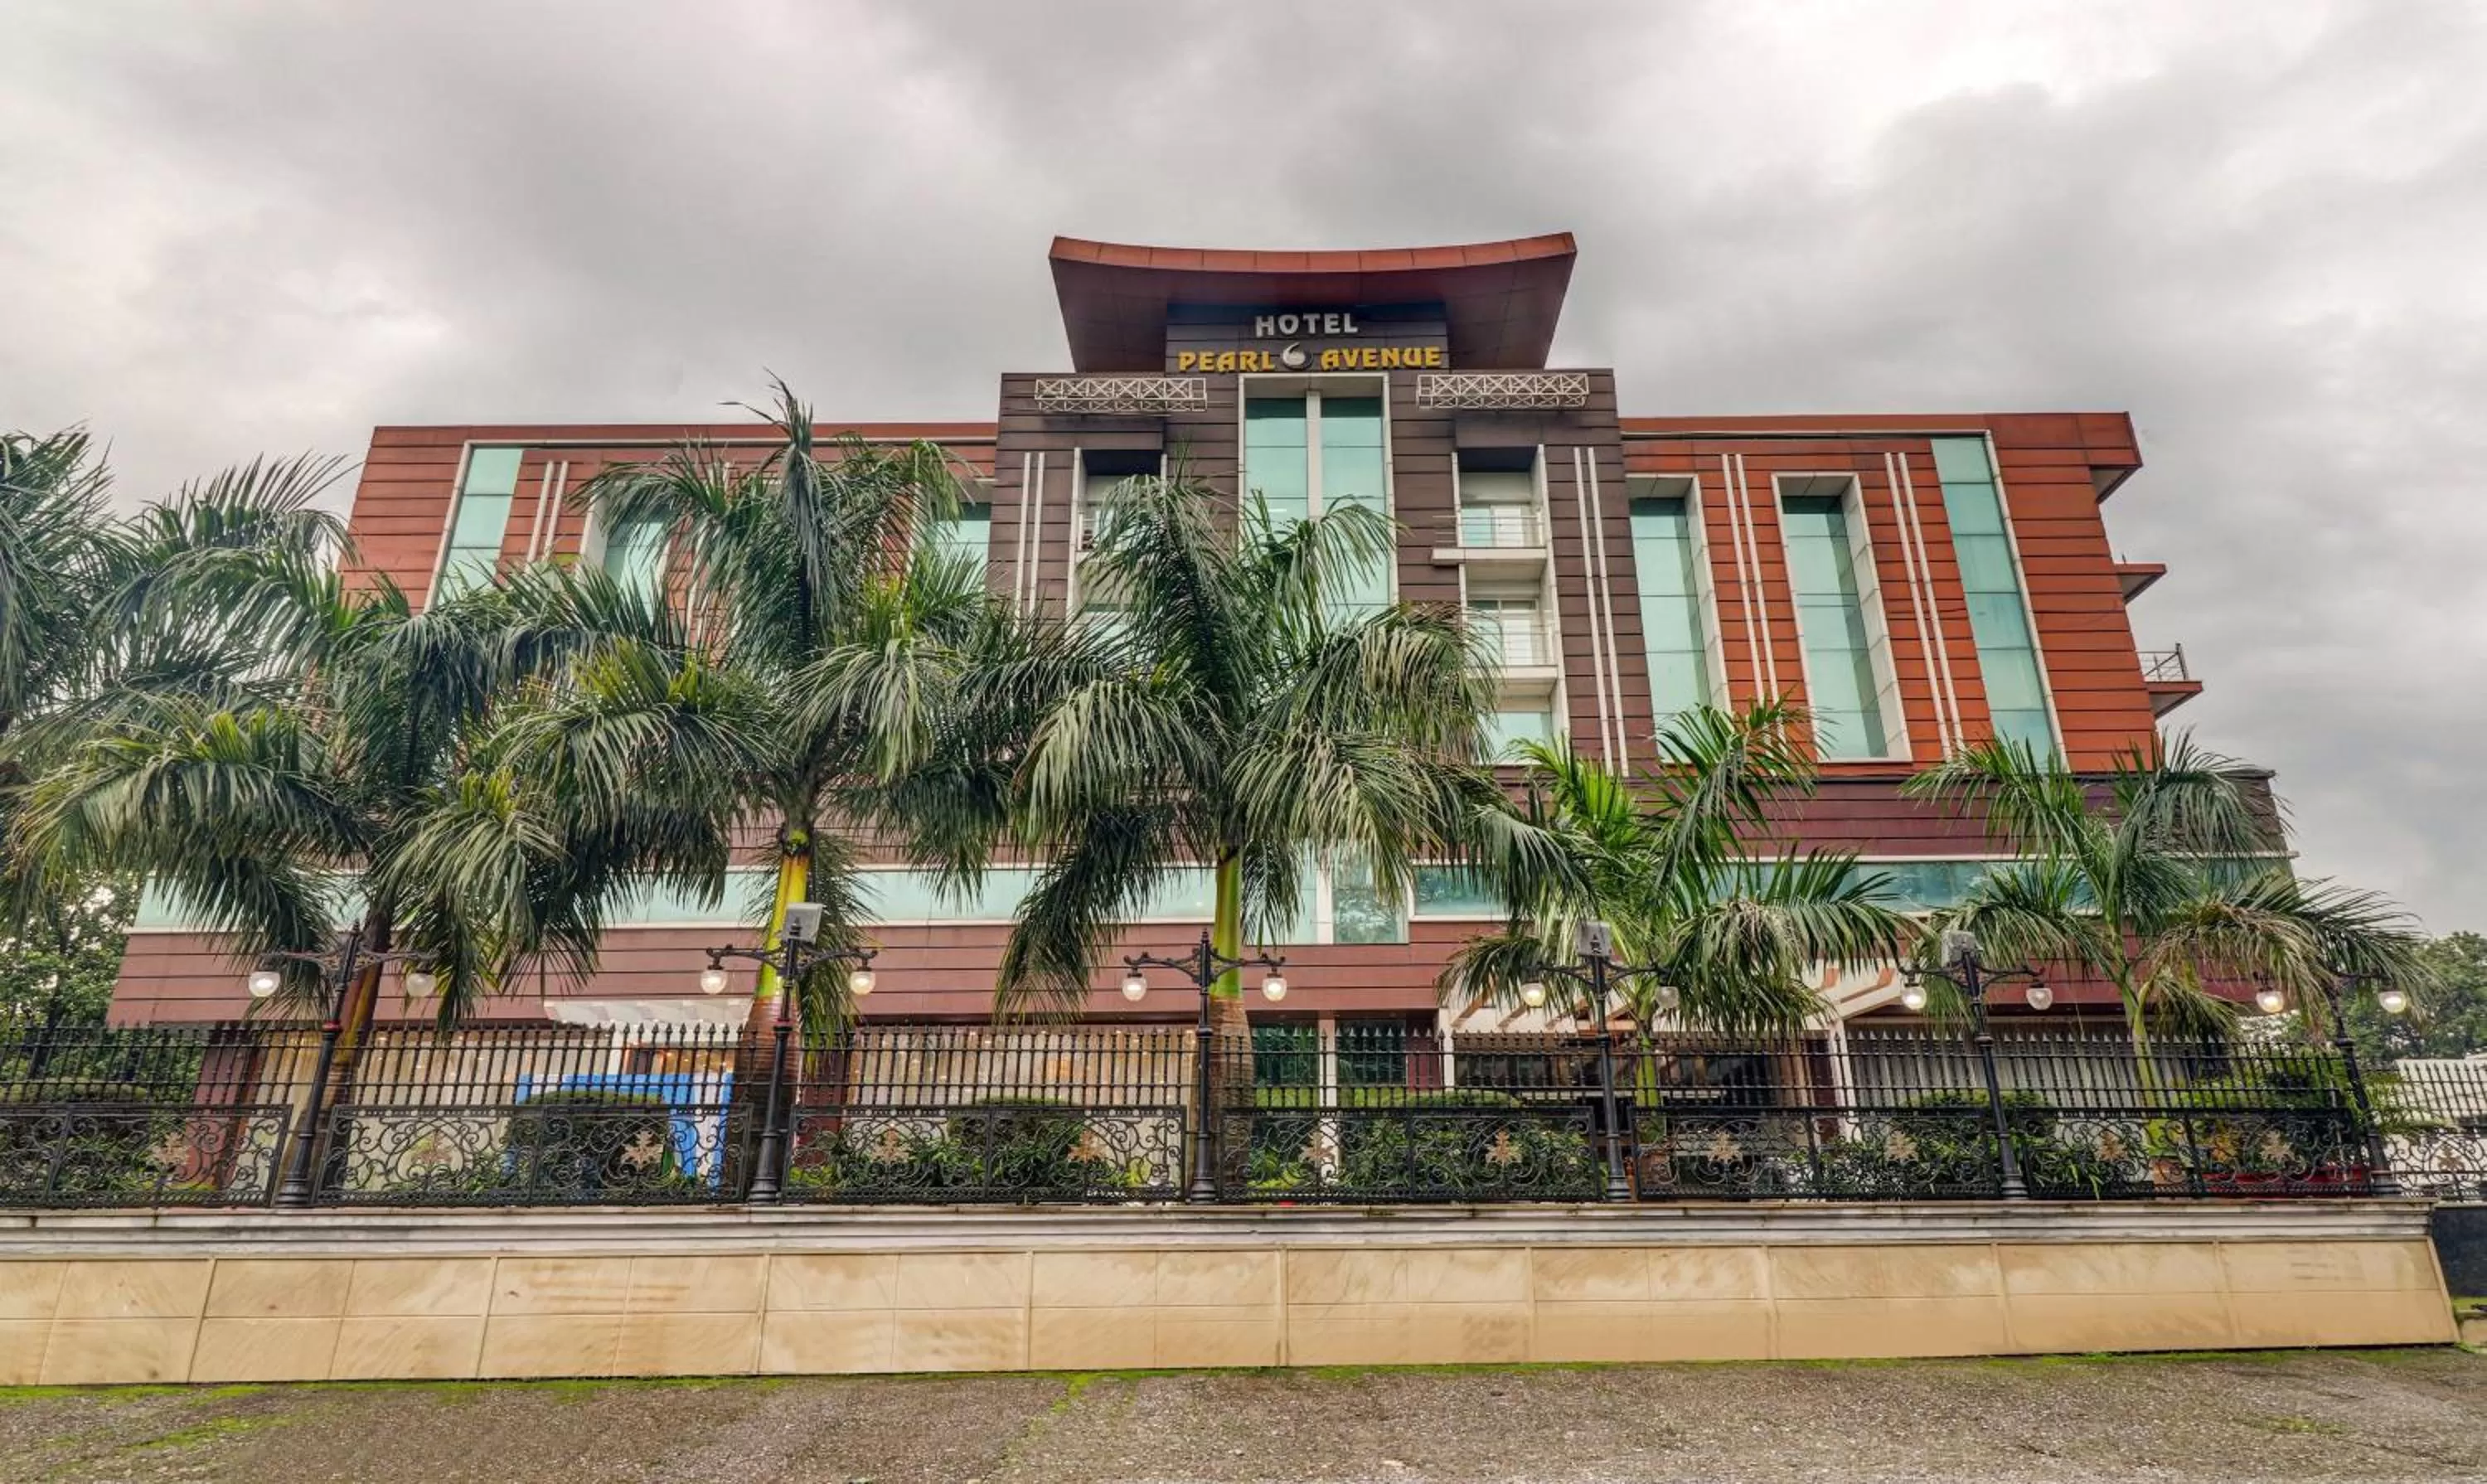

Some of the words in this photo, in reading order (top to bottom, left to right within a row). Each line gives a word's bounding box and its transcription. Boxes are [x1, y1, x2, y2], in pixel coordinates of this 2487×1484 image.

[1254, 313, 1359, 337] HOTEL
[1178, 350, 1277, 372] PEARL
[1320, 347, 1442, 371] AVENUE
